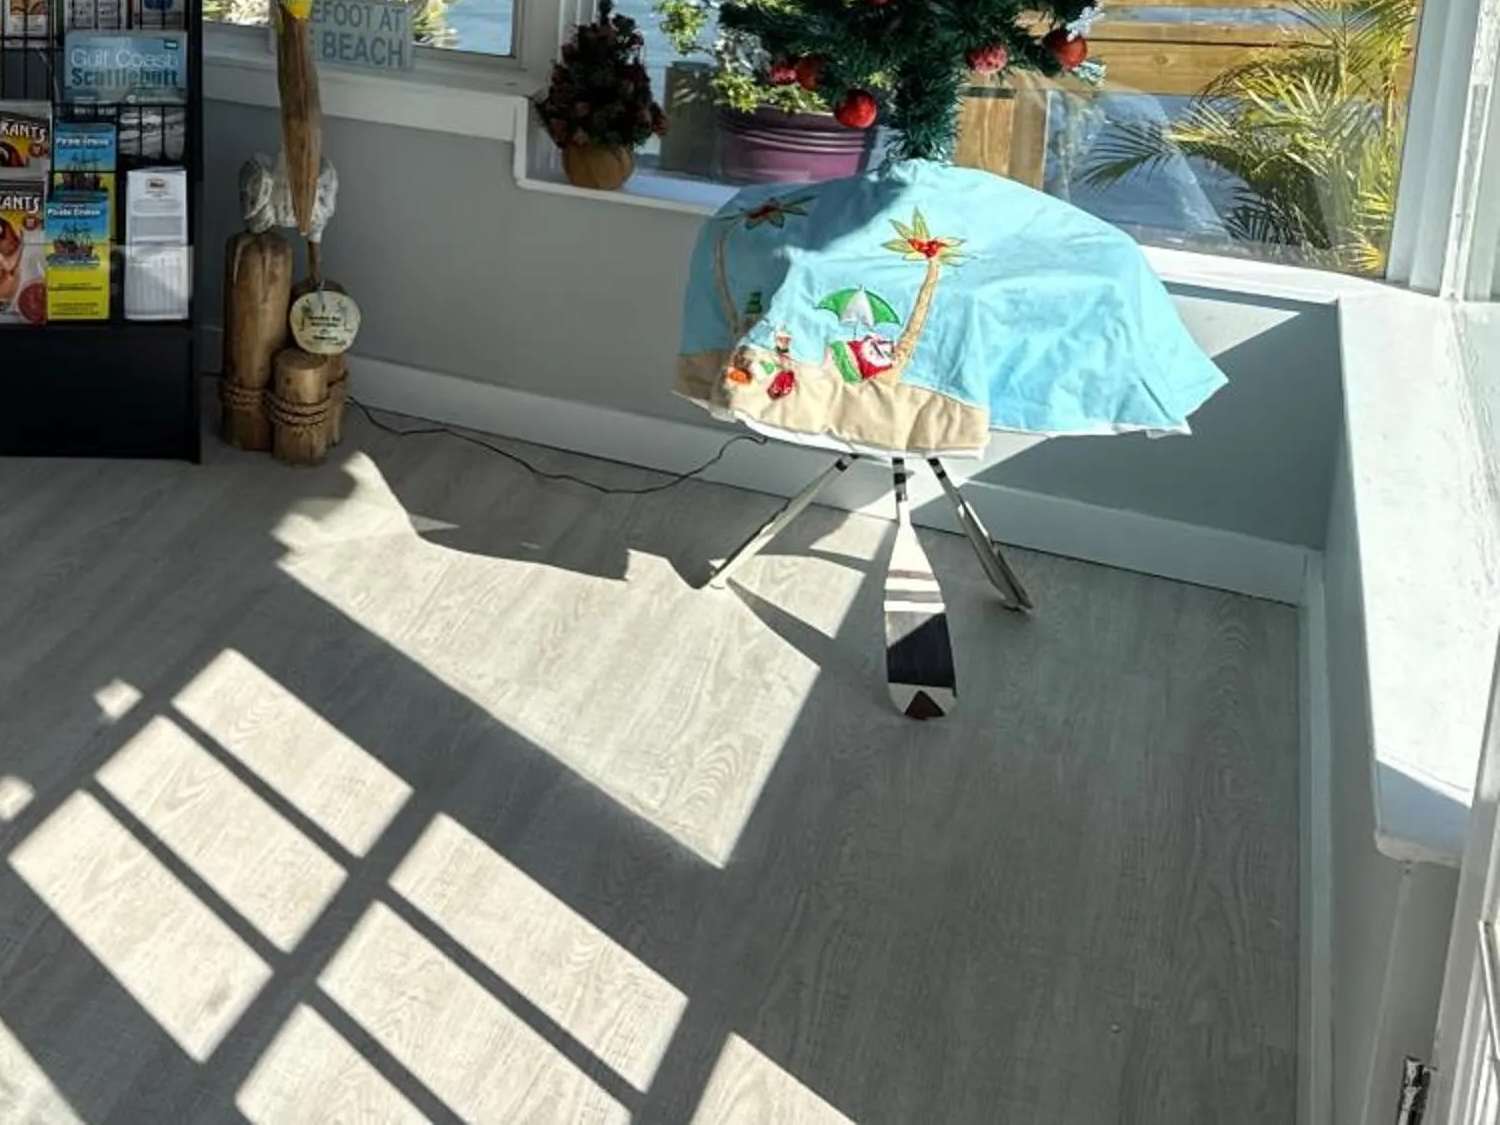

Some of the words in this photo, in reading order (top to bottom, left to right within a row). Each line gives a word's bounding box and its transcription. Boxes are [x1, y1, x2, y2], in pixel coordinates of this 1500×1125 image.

[312, 0, 372, 27] EFOOT
[379, 5, 403, 32] AT
[322, 31, 404, 67] BEACH
